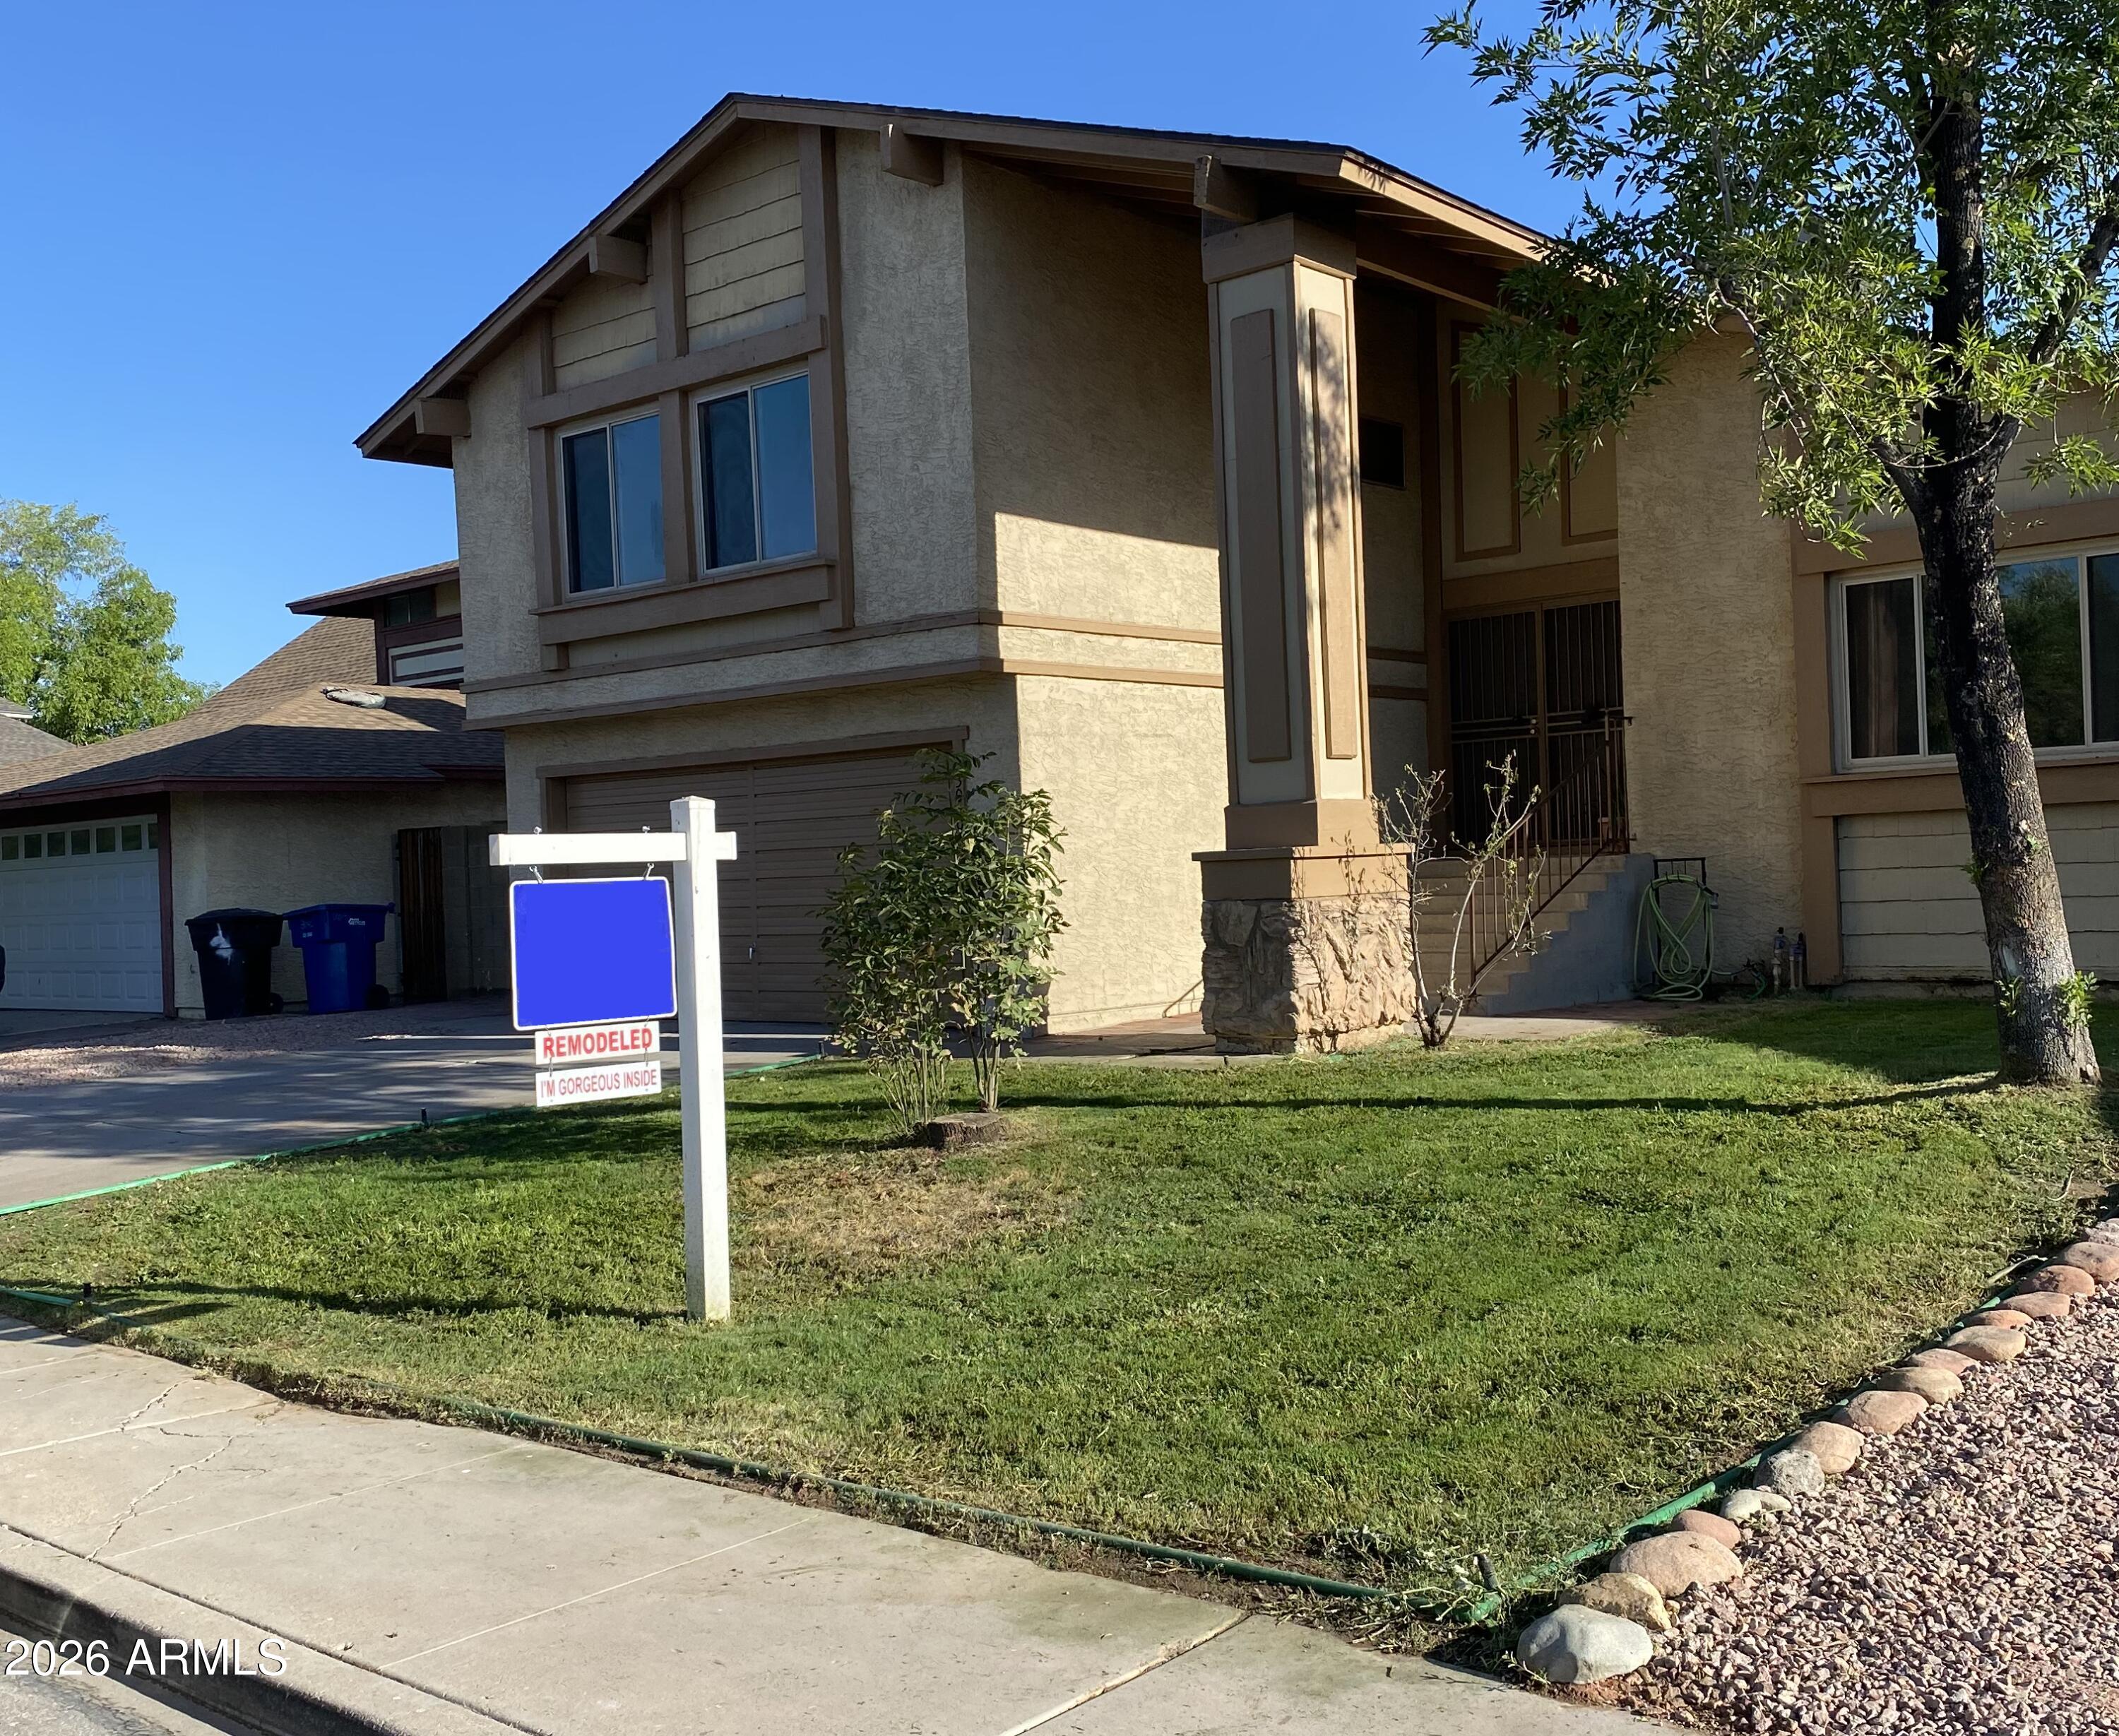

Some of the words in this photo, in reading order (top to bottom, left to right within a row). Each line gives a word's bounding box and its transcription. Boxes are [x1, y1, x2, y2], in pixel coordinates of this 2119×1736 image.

[543, 1028, 653, 1058] REMODELED
[541, 1079, 555, 1098] I'M
[559, 1072, 620, 1095] GORGEOUS
[623, 1069, 657, 1089] INSIDE
